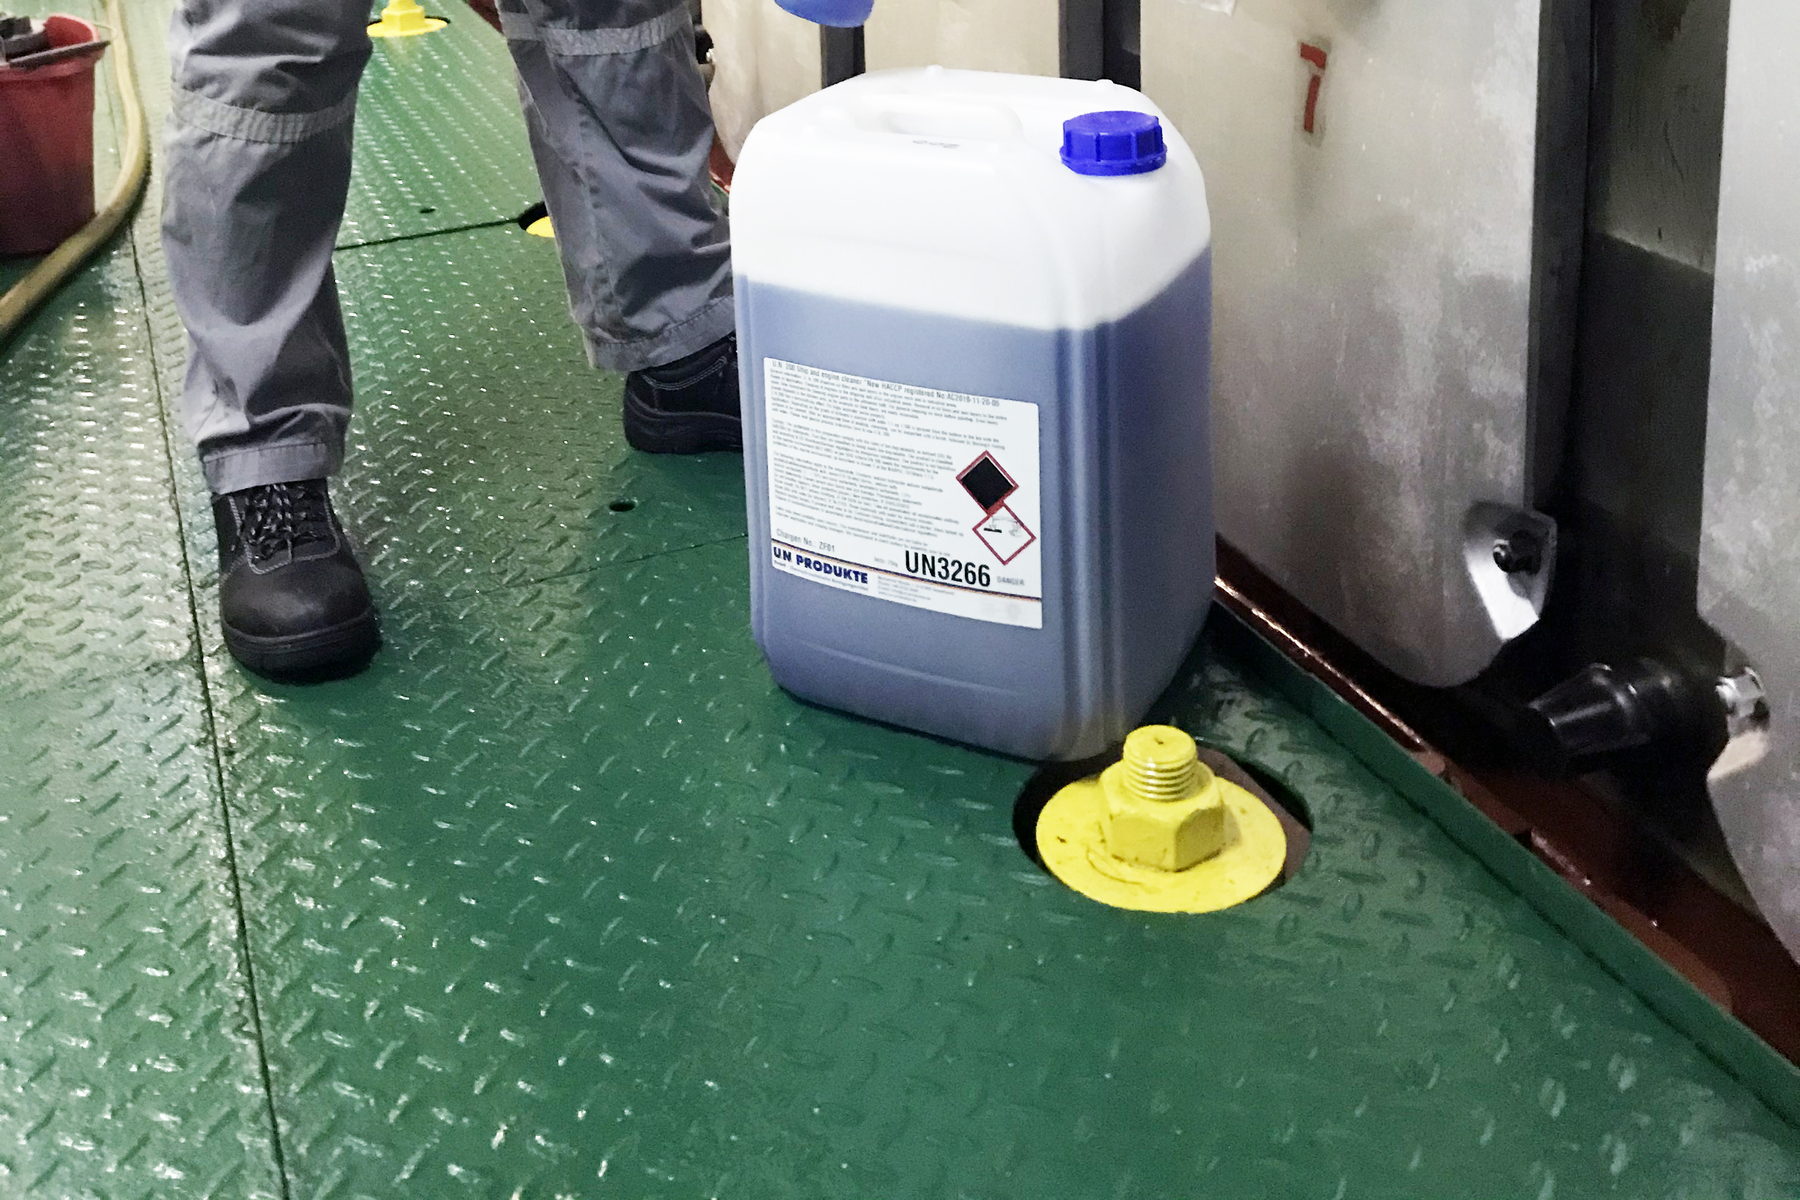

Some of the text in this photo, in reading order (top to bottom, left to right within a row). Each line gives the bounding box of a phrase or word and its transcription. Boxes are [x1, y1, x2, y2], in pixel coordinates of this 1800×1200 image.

[1300, 42, 1327, 134] 7
[773, 546, 792, 562] UN
[796, 554, 868, 584] PRODUKTE
[905, 550, 991, 587] UN3266
